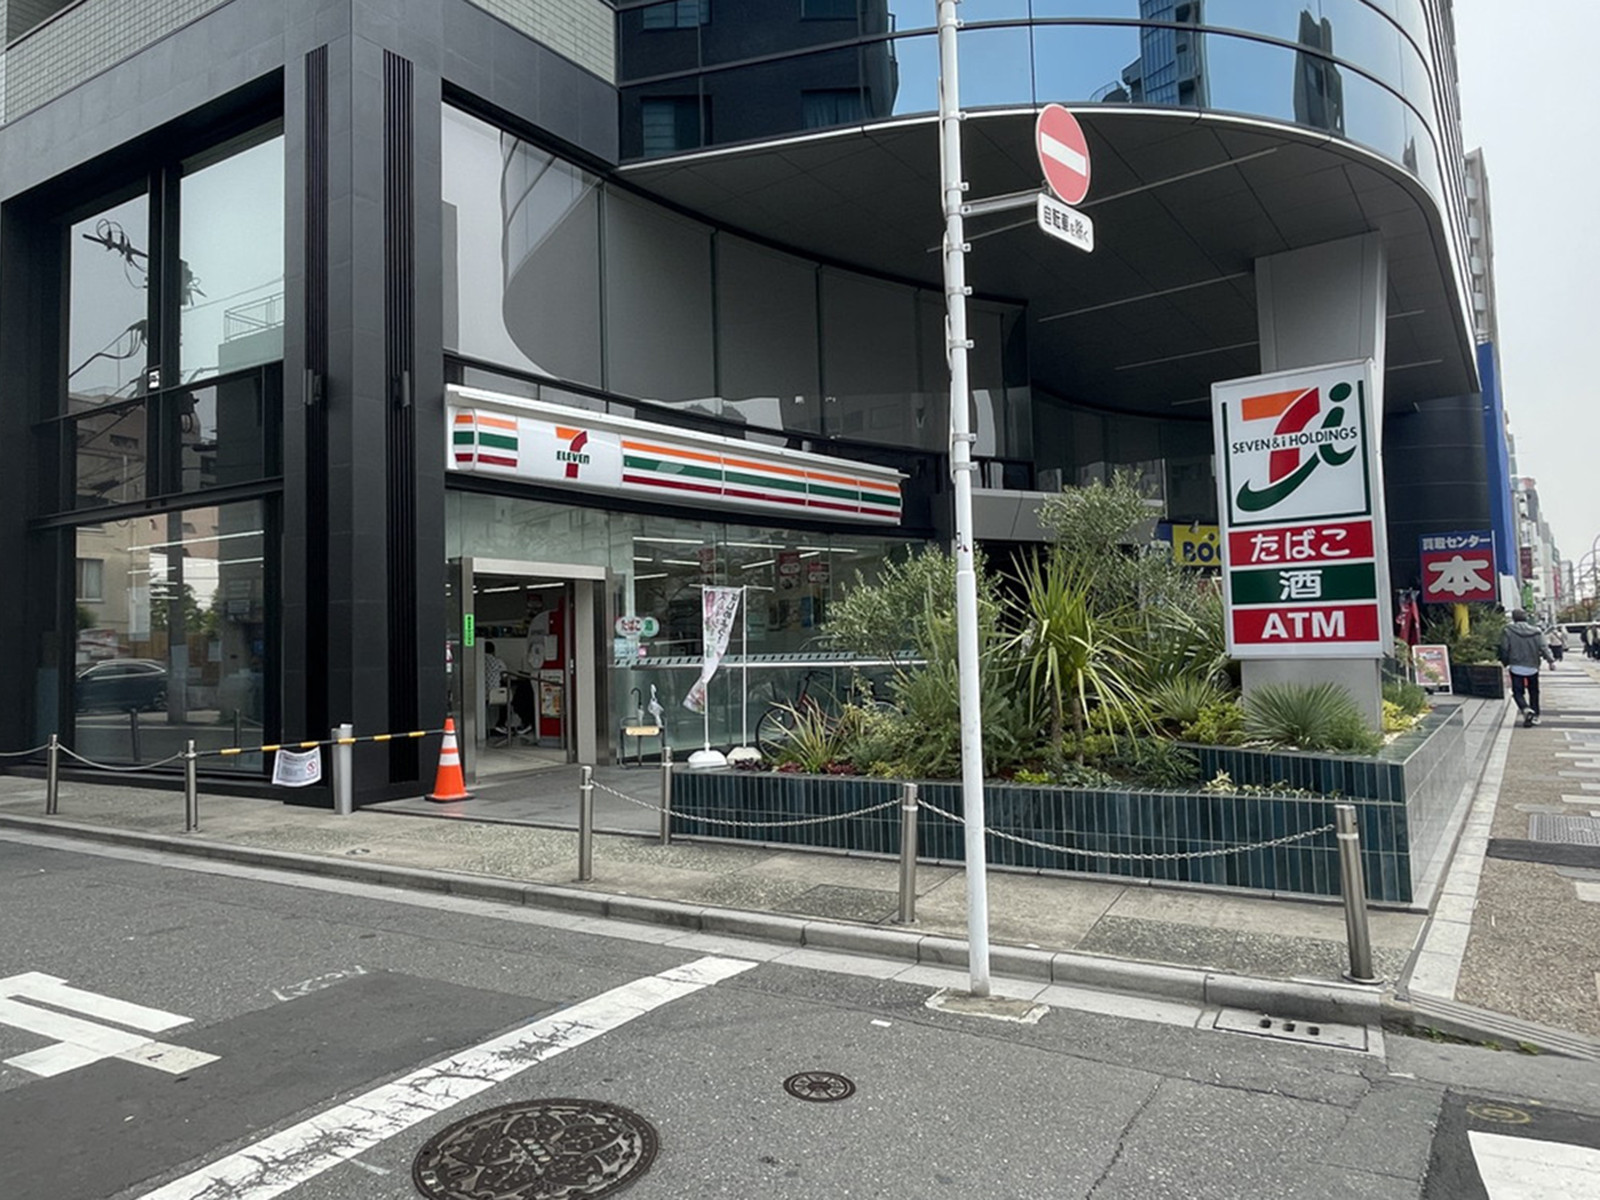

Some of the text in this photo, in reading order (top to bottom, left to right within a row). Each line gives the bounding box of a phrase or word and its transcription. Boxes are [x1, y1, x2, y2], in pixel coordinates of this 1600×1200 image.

[1289, 426, 1358, 447] HOLDINGS
[1250, 528, 1350, 562] たばこ
[1279, 569, 1323, 600] 酒
[1428, 555, 1491, 596] 本
[1261, 610, 1346, 639] ATM
